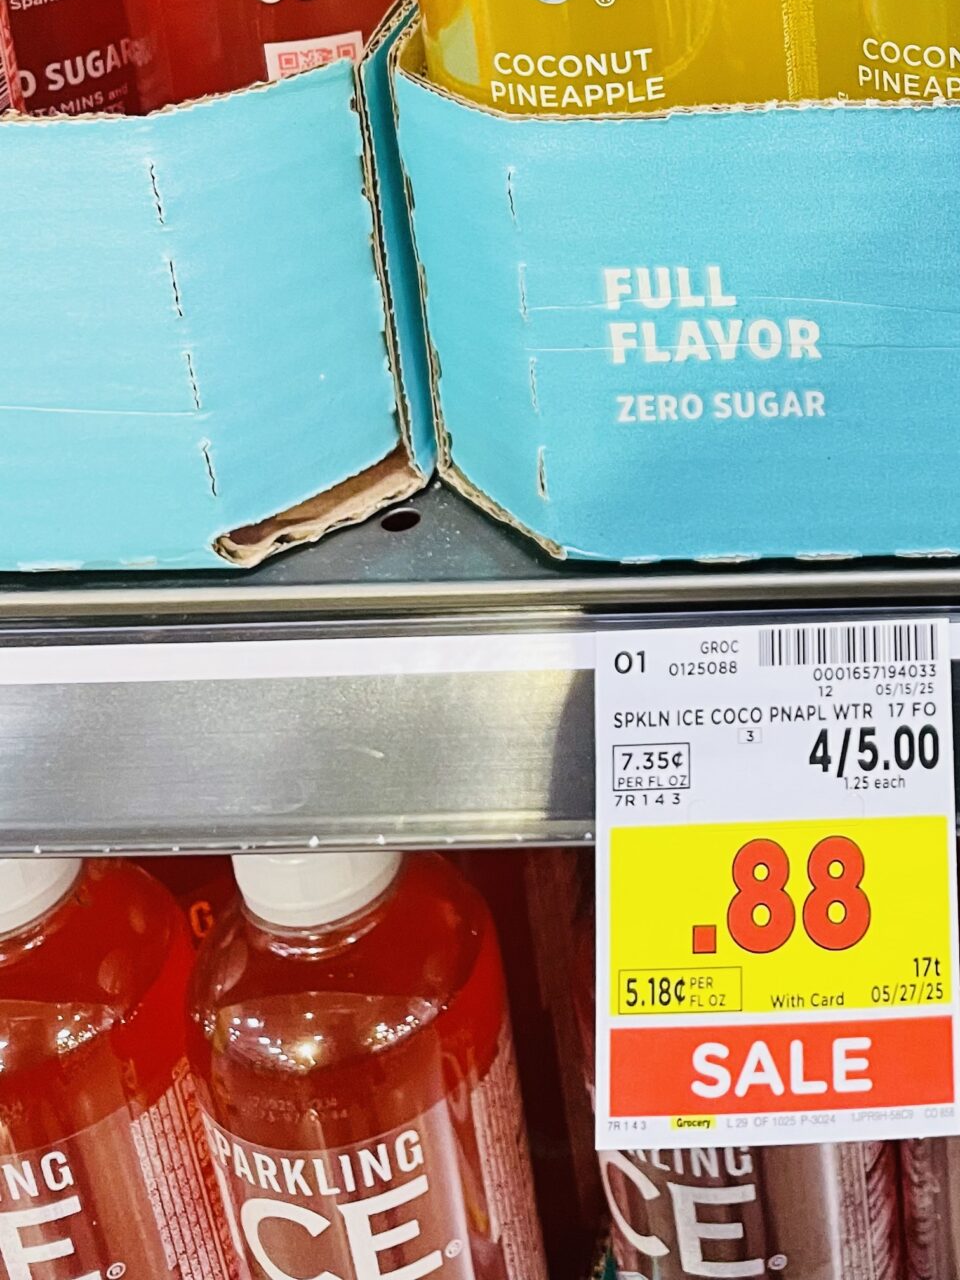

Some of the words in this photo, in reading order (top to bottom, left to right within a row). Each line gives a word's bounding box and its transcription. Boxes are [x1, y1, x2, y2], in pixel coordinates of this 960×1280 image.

[494, 48, 653, 78] COCONUT
[490, 76, 666, 108] PINEAPPLE
[603, 265, 737, 310] FULL
[609, 318, 822, 364] FLAVOR
[616, 393, 704, 423] ZERO
[713, 390, 826, 419] SUGAR
[700, 640, 739, 655] GROC
[669, 660, 738, 677] 0125088
[813, 664, 937, 681] 0001657194033
[818, 685, 833, 697] 12
[875, 682, 934, 697] 05/15/25
[613, 710, 671, 729] SPKLN
[677, 708, 704, 726] ICE
[711, 706, 763, 725] COCO
[770, 704, 826, 723] PNAPL
[833, 703, 873, 721] WTR
[888, 703, 904, 718] 17
[912, 701, 937, 717] FO
[746, 730, 755, 743] 3
[621, 750, 684, 771] 7.35¢
[809, 723, 940, 779] 4/5.00
[617, 776, 644, 788] PER
[648, 775, 665, 787] FL
[668, 774, 688, 787] OZ
[874, 775, 906, 790] each
[692, 835, 871, 954] .88
[913, 957, 941, 977] 17t
[625, 975, 686, 1007] 5.18¢
[689, 976, 714, 990] PER
[690, 995, 705, 1007] FL
[708, 994, 726, 1007] OZ
[770, 992, 805, 1008] With
[810, 992, 845, 1007] Card
[871, 982, 944, 1005] 05/27/25
[690, 1036, 873, 1099] SALE
[676, 1117, 711, 1129] Grocery
[210, 1129, 425, 1196] PARKLING
